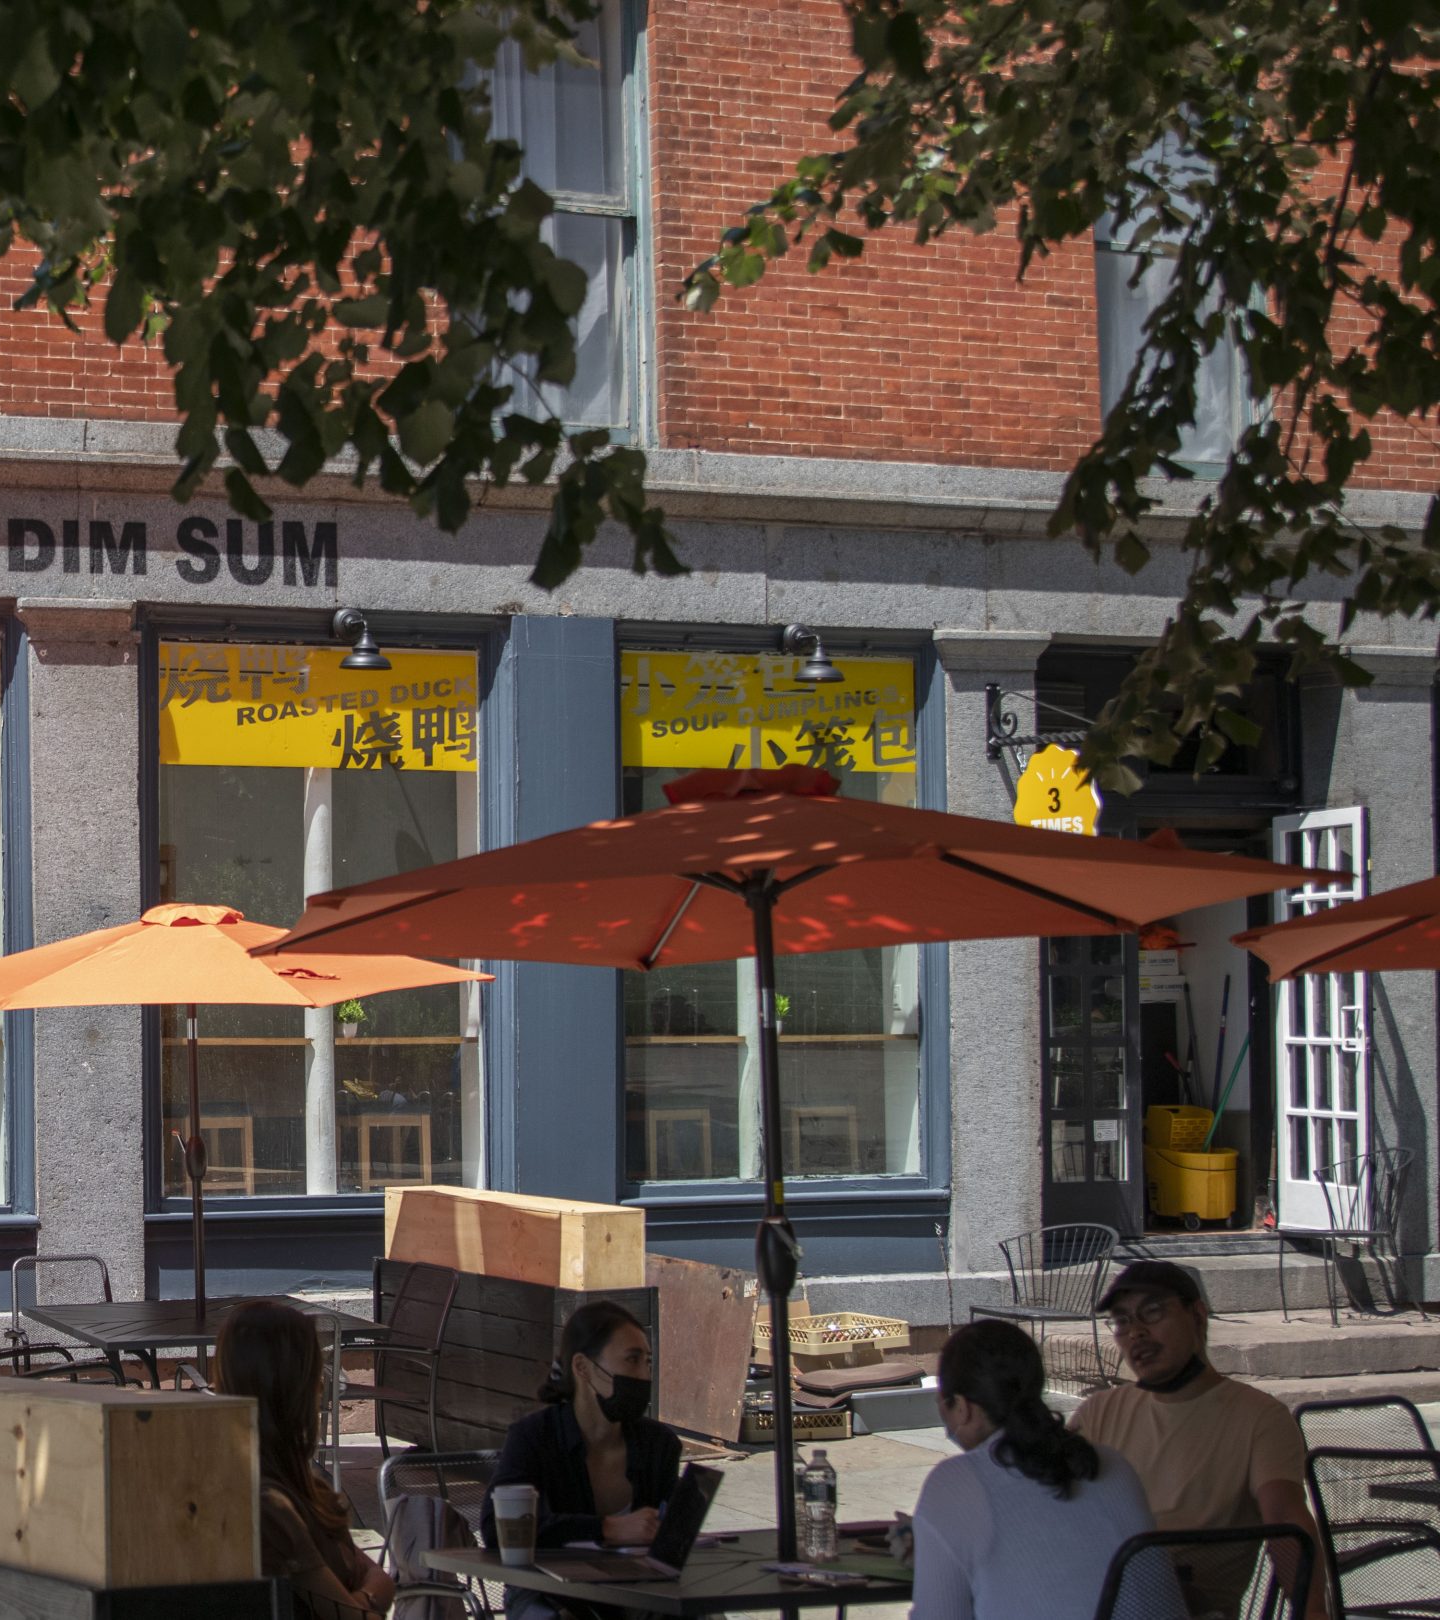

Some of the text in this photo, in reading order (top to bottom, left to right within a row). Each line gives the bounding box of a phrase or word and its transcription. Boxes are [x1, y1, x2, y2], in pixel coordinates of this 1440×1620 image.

[8, 518, 149, 576] DIM
[175, 515, 340, 588] SUM
[236, 676, 476, 727] ROASTED DUCK
[652, 709, 728, 739] SOUP
[331, 703, 477, 770] 烧鸭
[727, 708, 915, 771] 小笼包
[1048, 787, 1061, 813] 3
